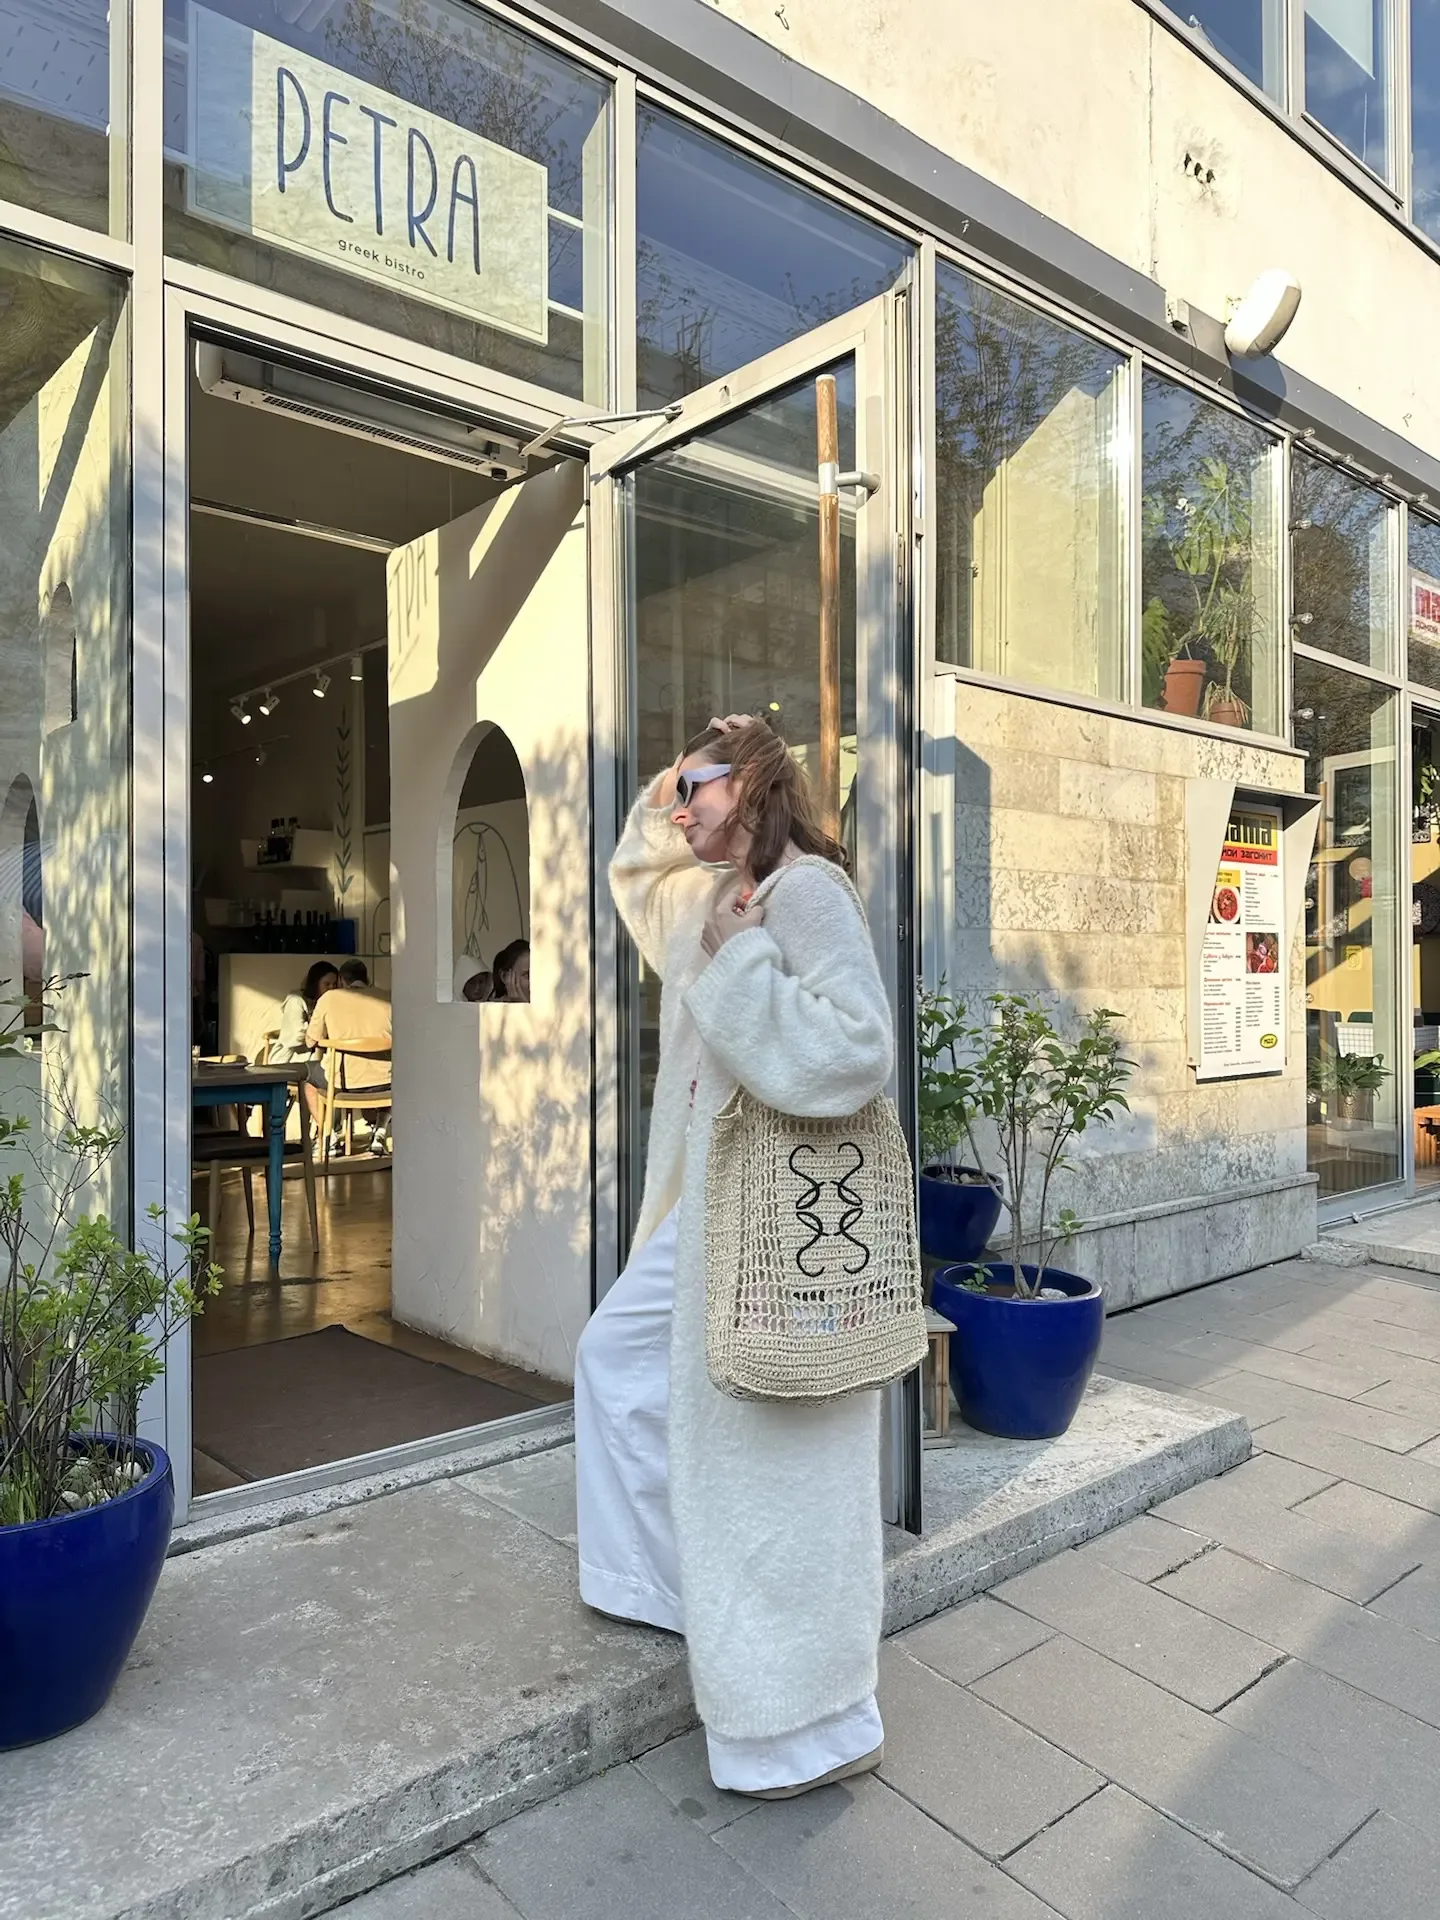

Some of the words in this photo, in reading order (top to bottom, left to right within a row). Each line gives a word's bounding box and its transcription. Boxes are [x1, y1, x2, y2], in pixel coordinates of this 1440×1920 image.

[277, 67, 481, 275] PETRA
[338, 239, 380, 262] greek
[385, 256, 425, 280] bistro
